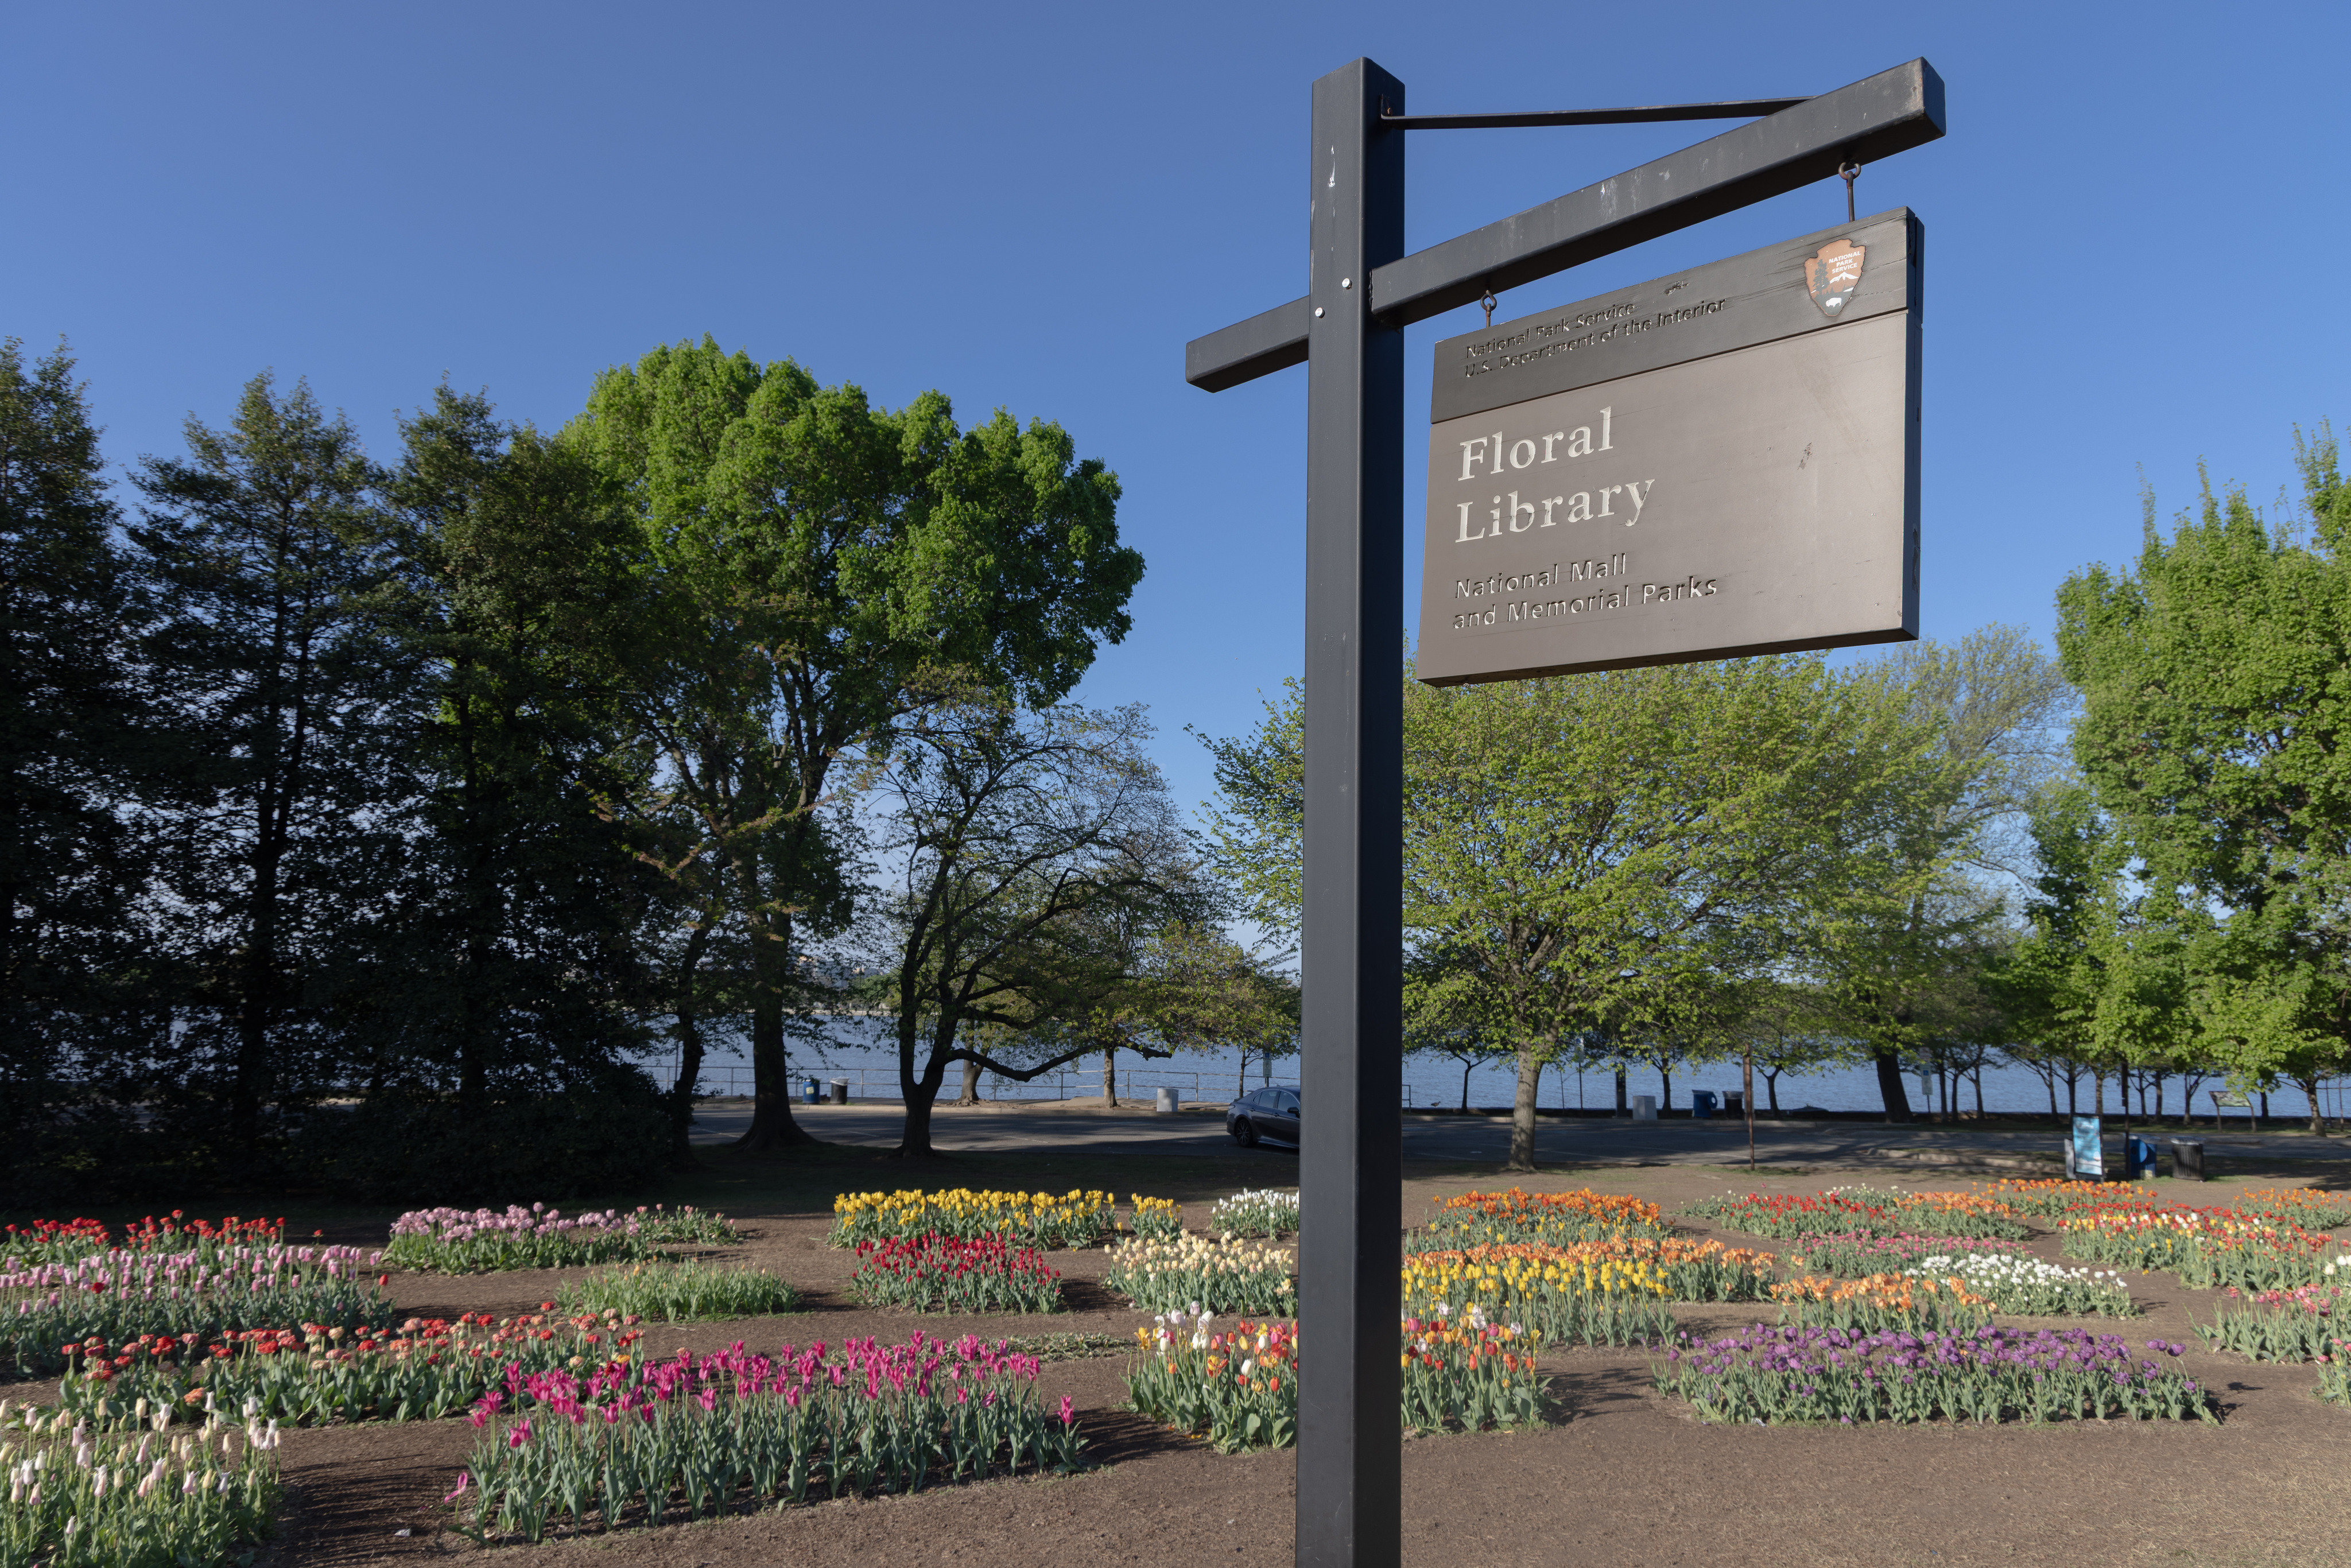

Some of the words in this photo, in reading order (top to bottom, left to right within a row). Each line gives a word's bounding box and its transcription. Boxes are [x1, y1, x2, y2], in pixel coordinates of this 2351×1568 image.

[1829, 251, 1861, 263] NATIONAL
[1832, 262, 1858, 274] SERVICE
[1836, 258, 1853, 267] PARK
[1465, 359, 1492, 378] U.S.
[1499, 332, 1596, 369] Department
[1600, 324, 1619, 342] of
[1624, 319, 1651, 336] the
[1658, 298, 1727, 327] Interior
[1467, 328, 1530, 358] National
[1536, 317, 1570, 340] Park
[1576, 304, 1635, 328] Service
[1458, 406, 1613, 481] Floral
[1455, 479, 1655, 543] Library
[1456, 563, 1558, 598] National
[1570, 552, 1626, 582] Mall
[1453, 604, 1496, 629] and
[1507, 584, 1629, 622] Memorial
[1642, 576, 1717, 604] Parks
